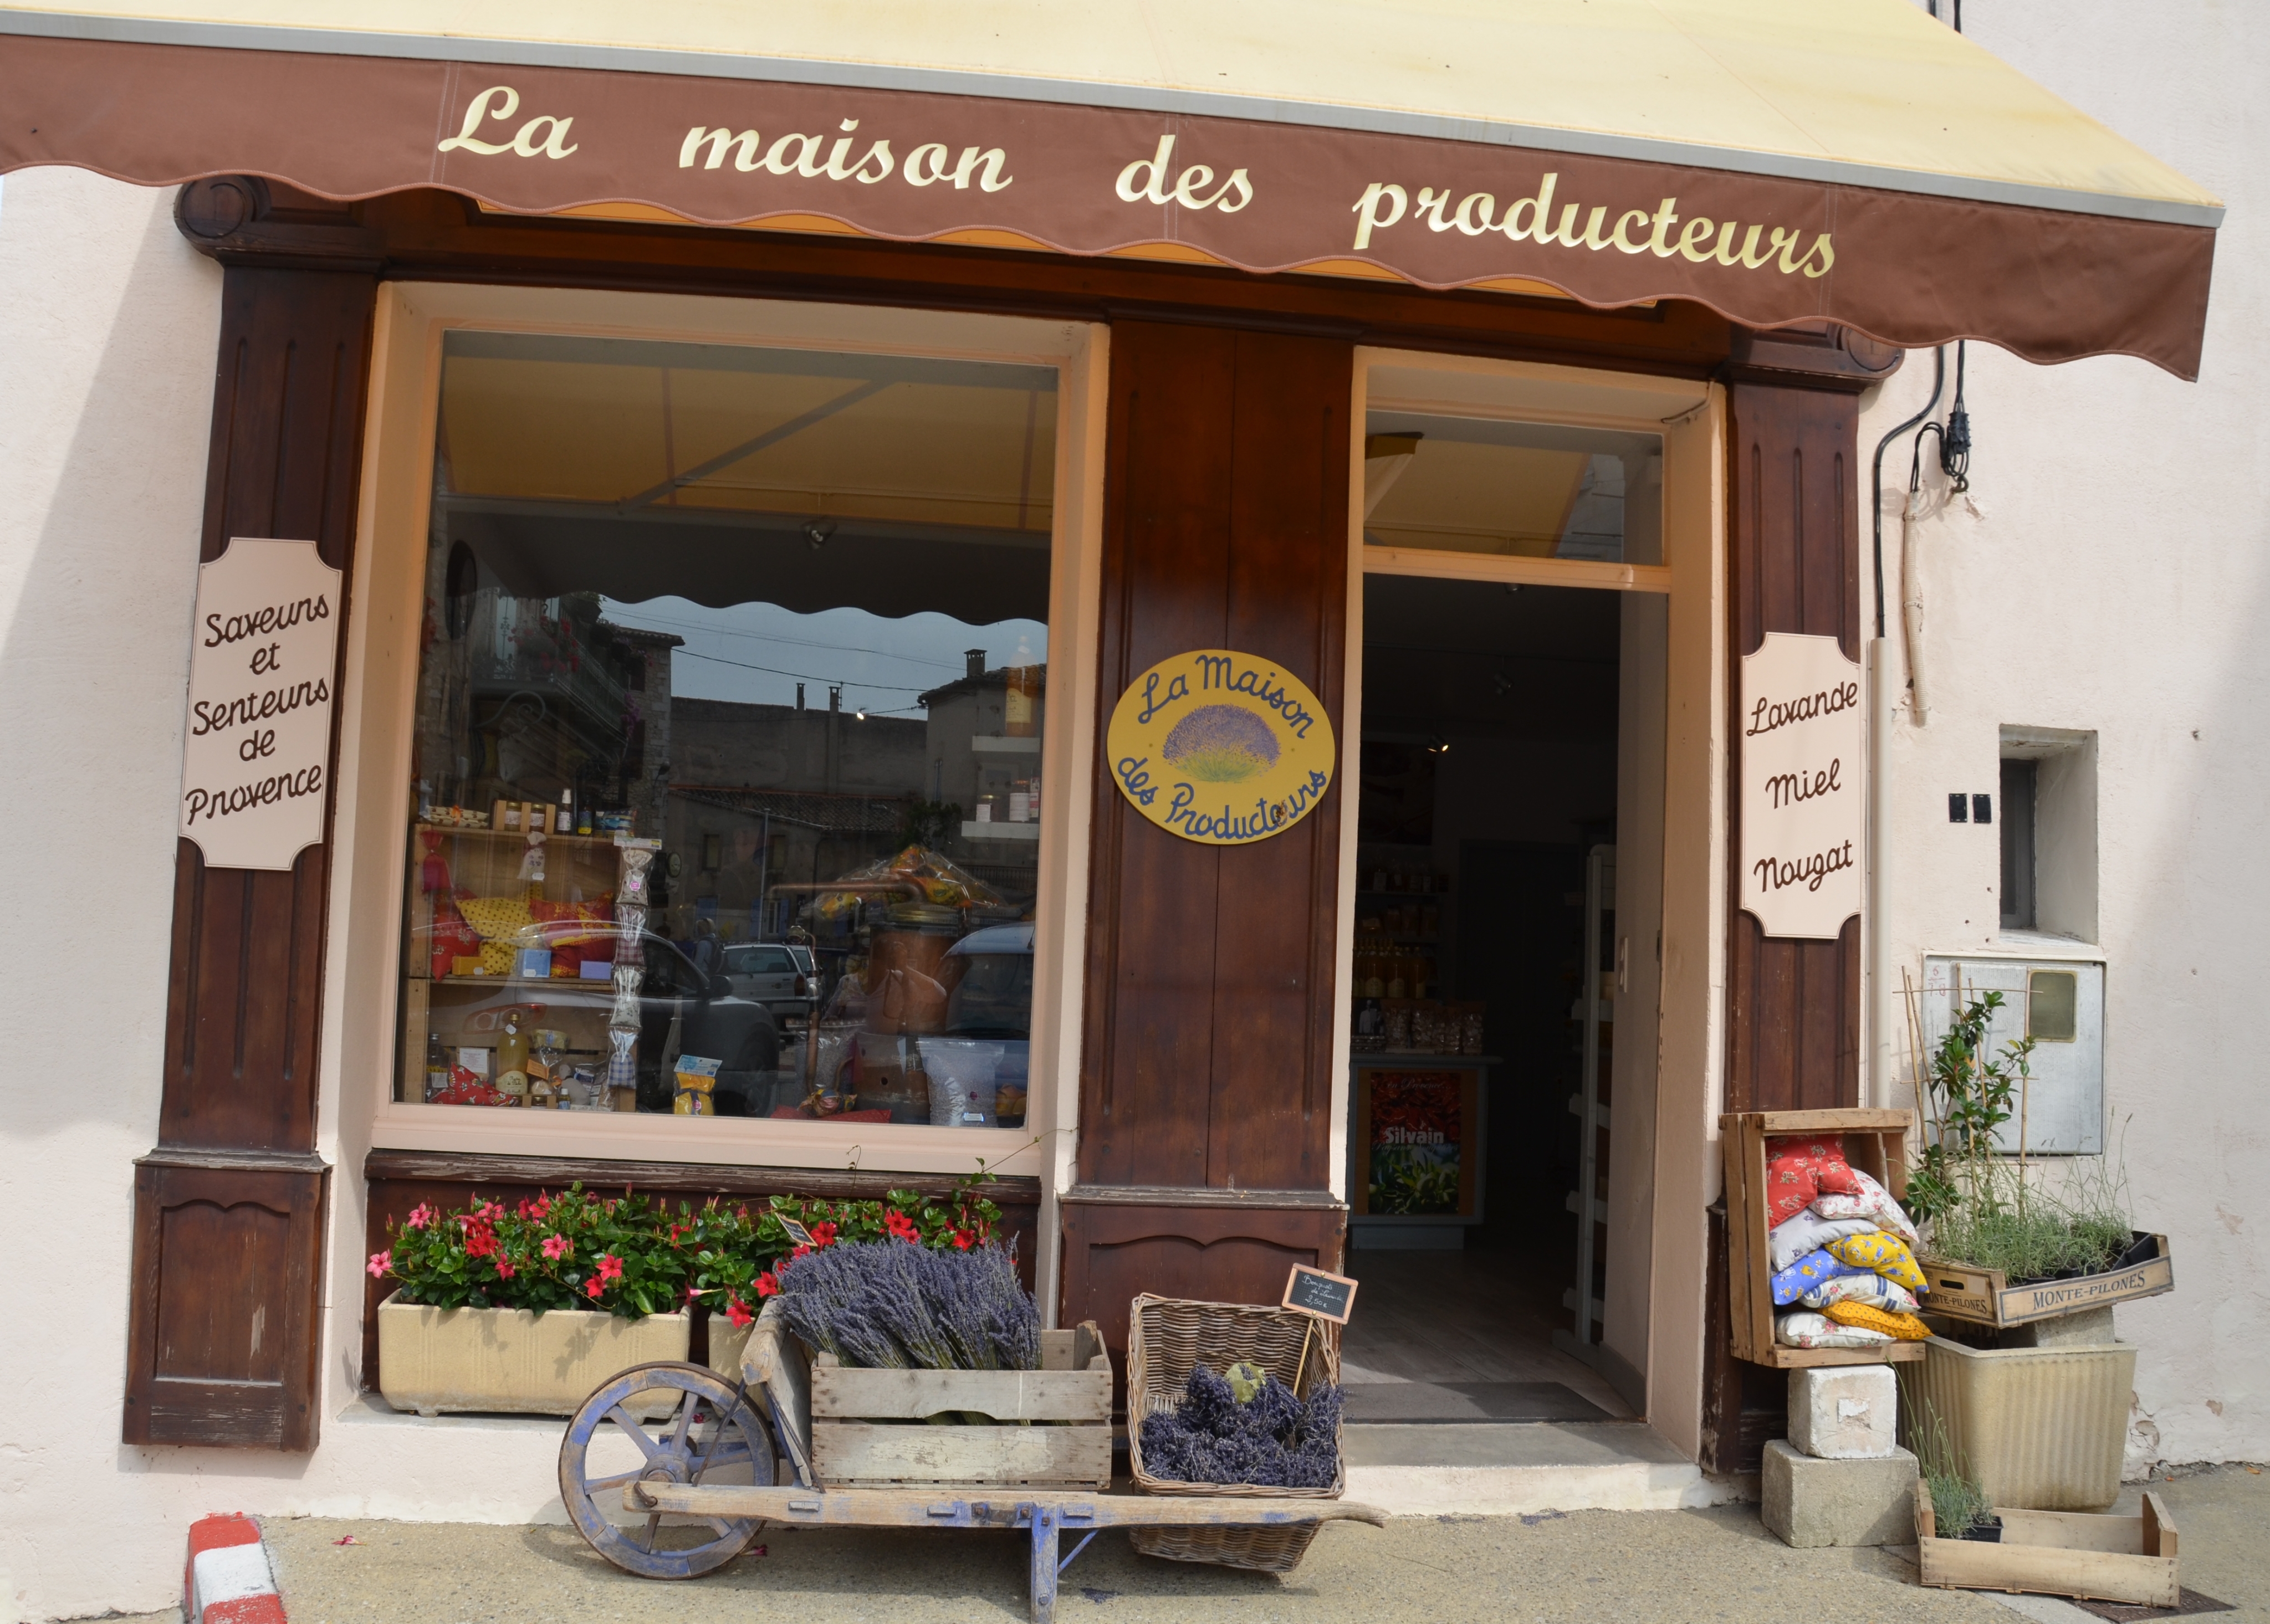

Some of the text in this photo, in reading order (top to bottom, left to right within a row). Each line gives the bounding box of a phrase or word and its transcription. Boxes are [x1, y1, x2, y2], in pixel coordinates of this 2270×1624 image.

[437, 86, 1836, 278] La maison des producteurs
[204, 594, 329, 647] Saveurs
[249, 642, 281, 675] et
[192, 678, 329, 736] Senteurs
[1137, 654, 1314, 740] La Maison
[1746, 681, 1858, 737] Lavande
[239, 729, 276, 762] de
[185, 765, 322, 826] Provence
[1117, 757, 1327, 840] des Producteurs
[1765, 757, 1841, 810] Miel
[1753, 839, 1853, 893] Nougat
[1385, 1126, 1444, 1144] Silvain
[1923, 1292, 1987, 1314] MONTE-PILONES
[2033, 1270, 2146, 1311] MONTE-PILONES
